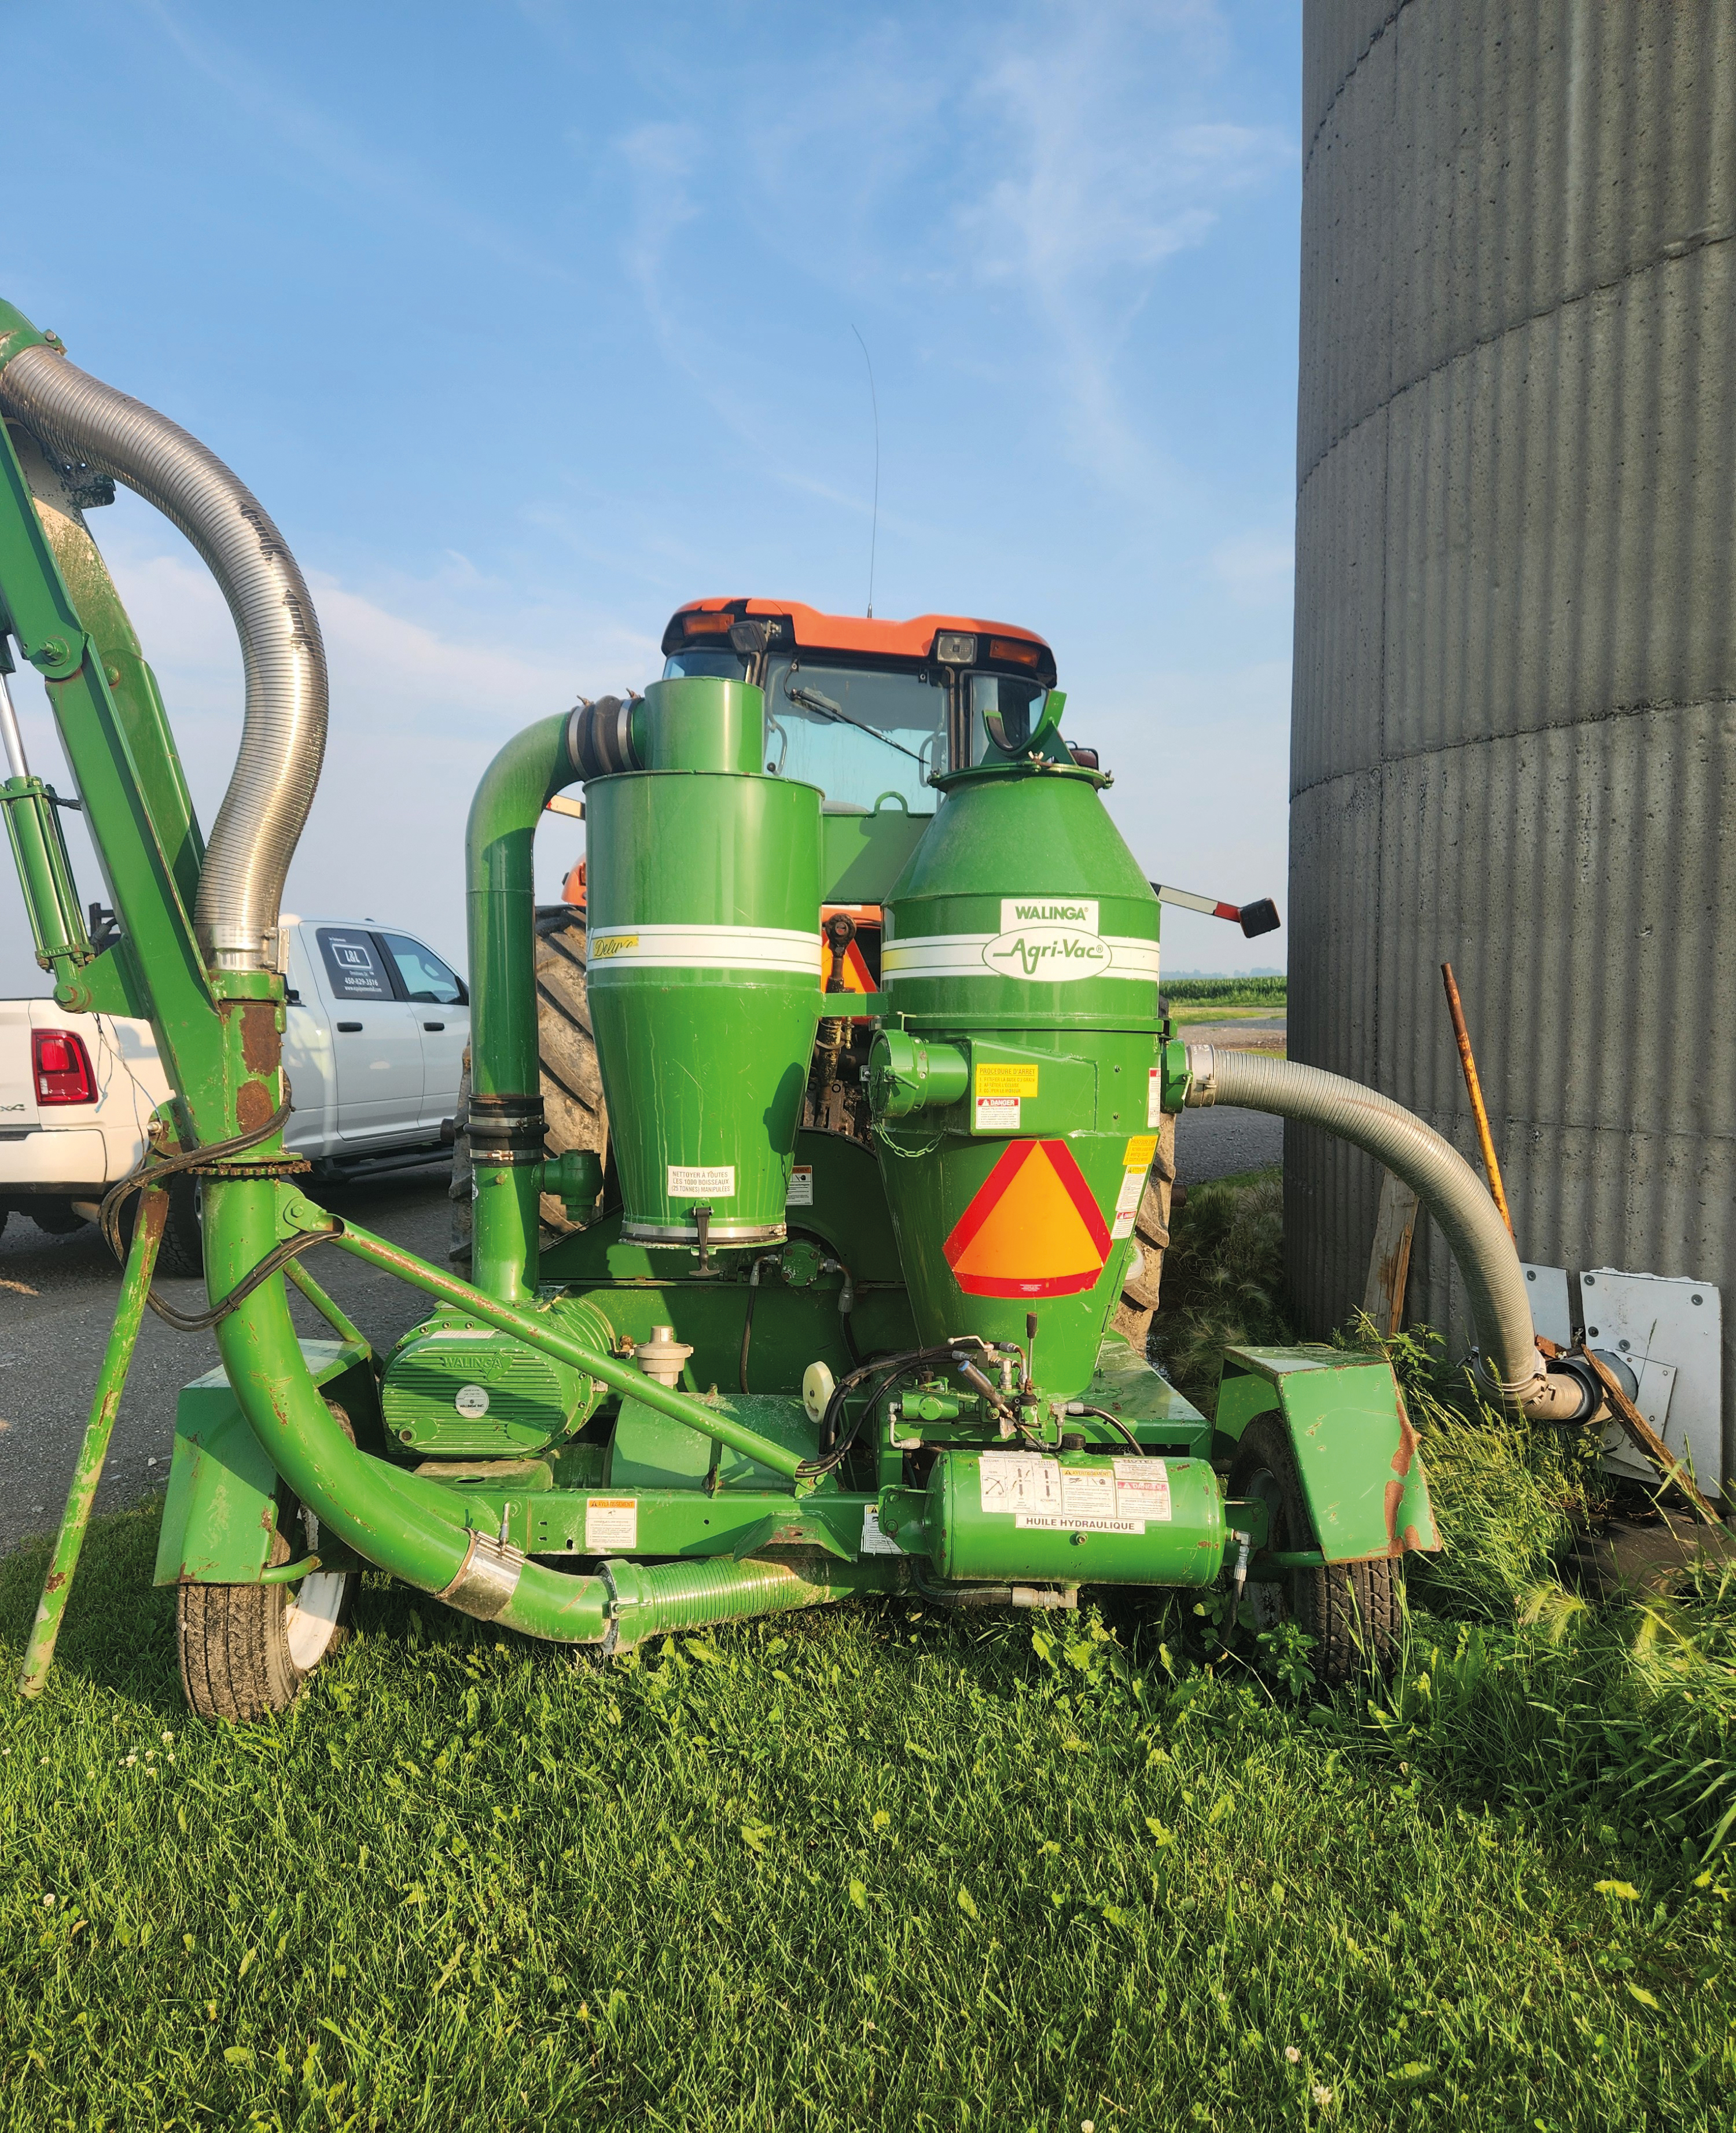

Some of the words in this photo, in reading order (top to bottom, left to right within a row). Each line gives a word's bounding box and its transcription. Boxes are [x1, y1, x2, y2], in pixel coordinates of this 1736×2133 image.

[443, 1357, 503, 1369] WALINGA
[1026, 1517, 1057, 1526] HUILE
[1060, 1519, 1135, 1530] HYDRAULIQUE
